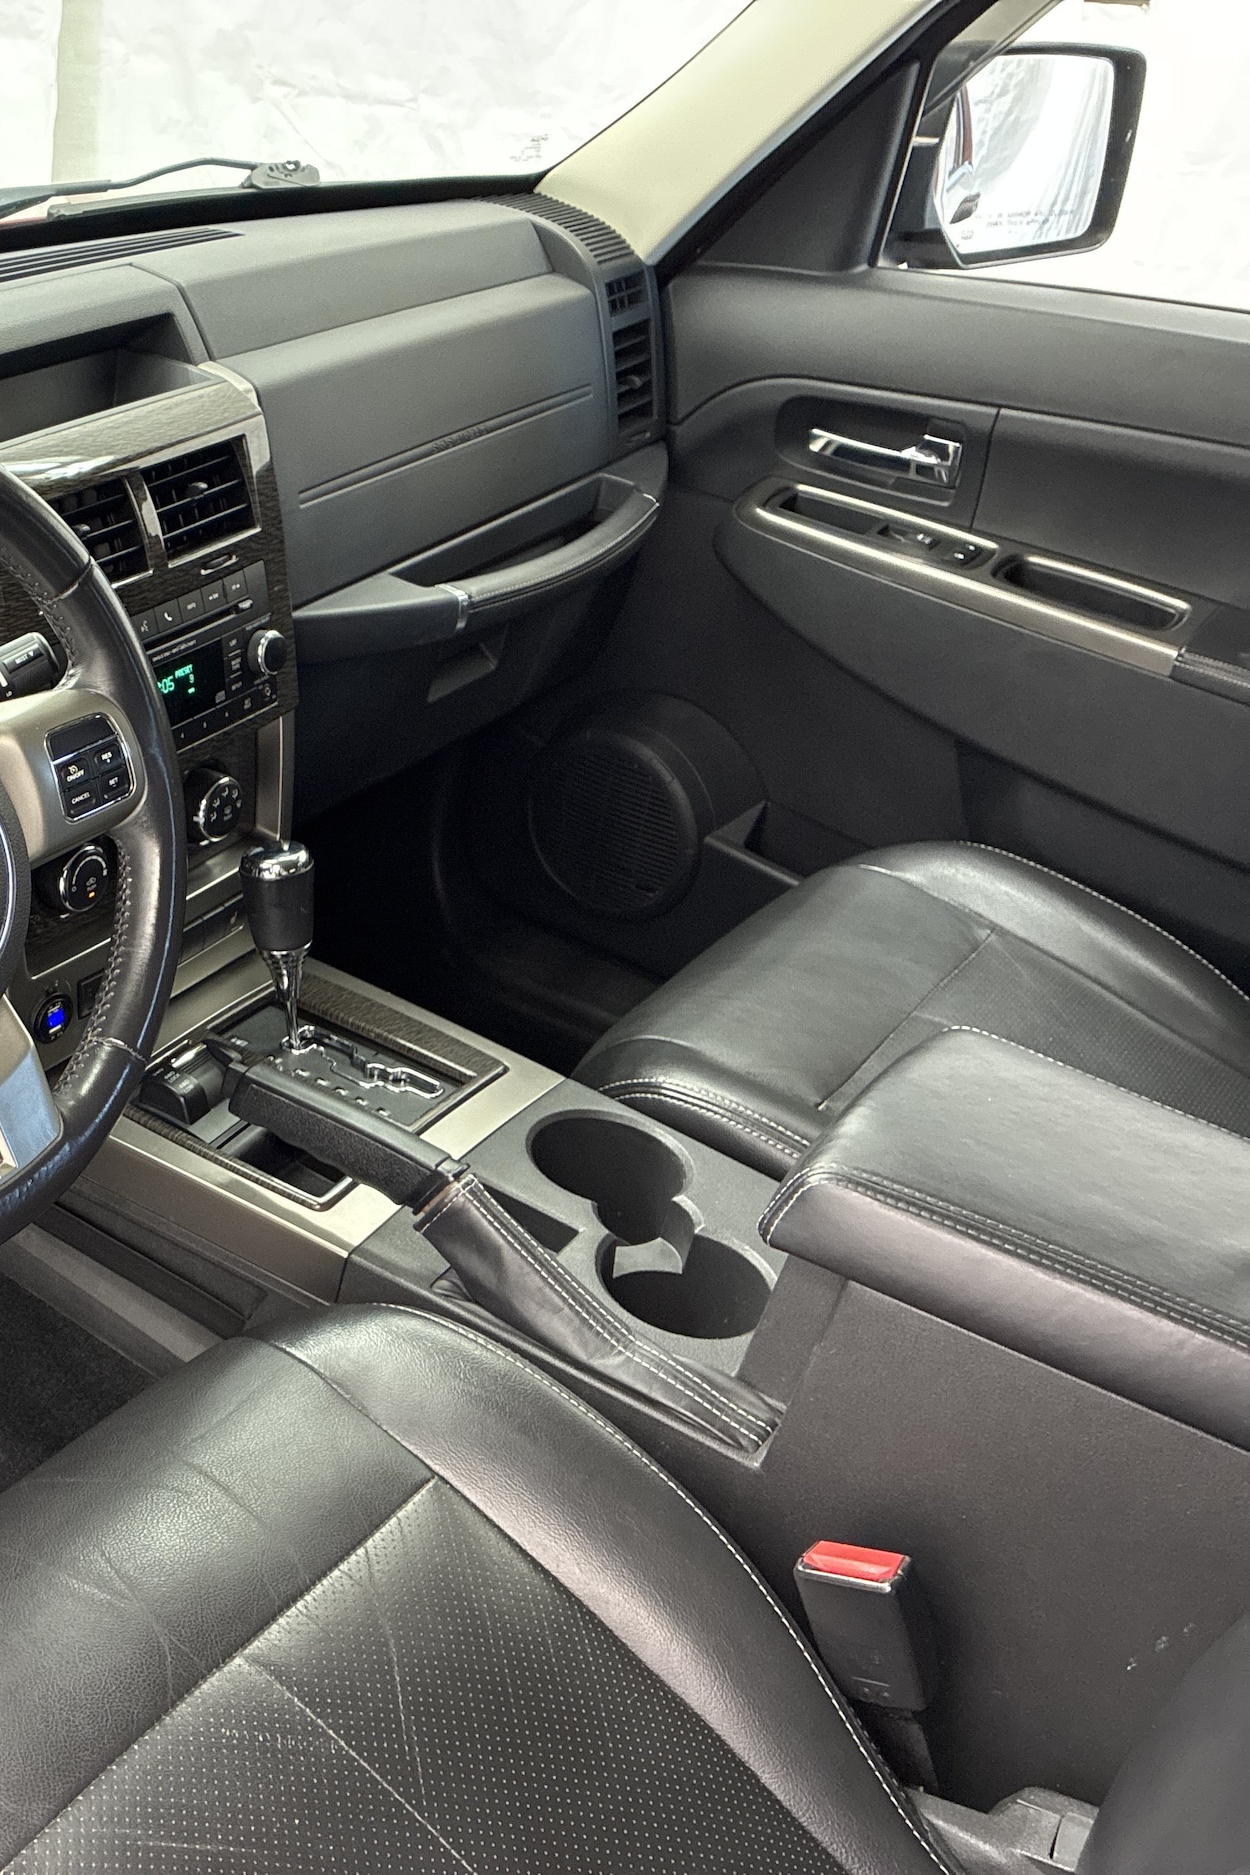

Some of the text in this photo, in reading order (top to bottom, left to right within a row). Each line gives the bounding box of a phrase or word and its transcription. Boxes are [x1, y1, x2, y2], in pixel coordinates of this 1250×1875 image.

[101, 751, 112, 760] RES
[67, 769, 84, 782] ON/OFF
[109, 777, 118, 785] SET
[71, 792, 90, 804] CANCEL
